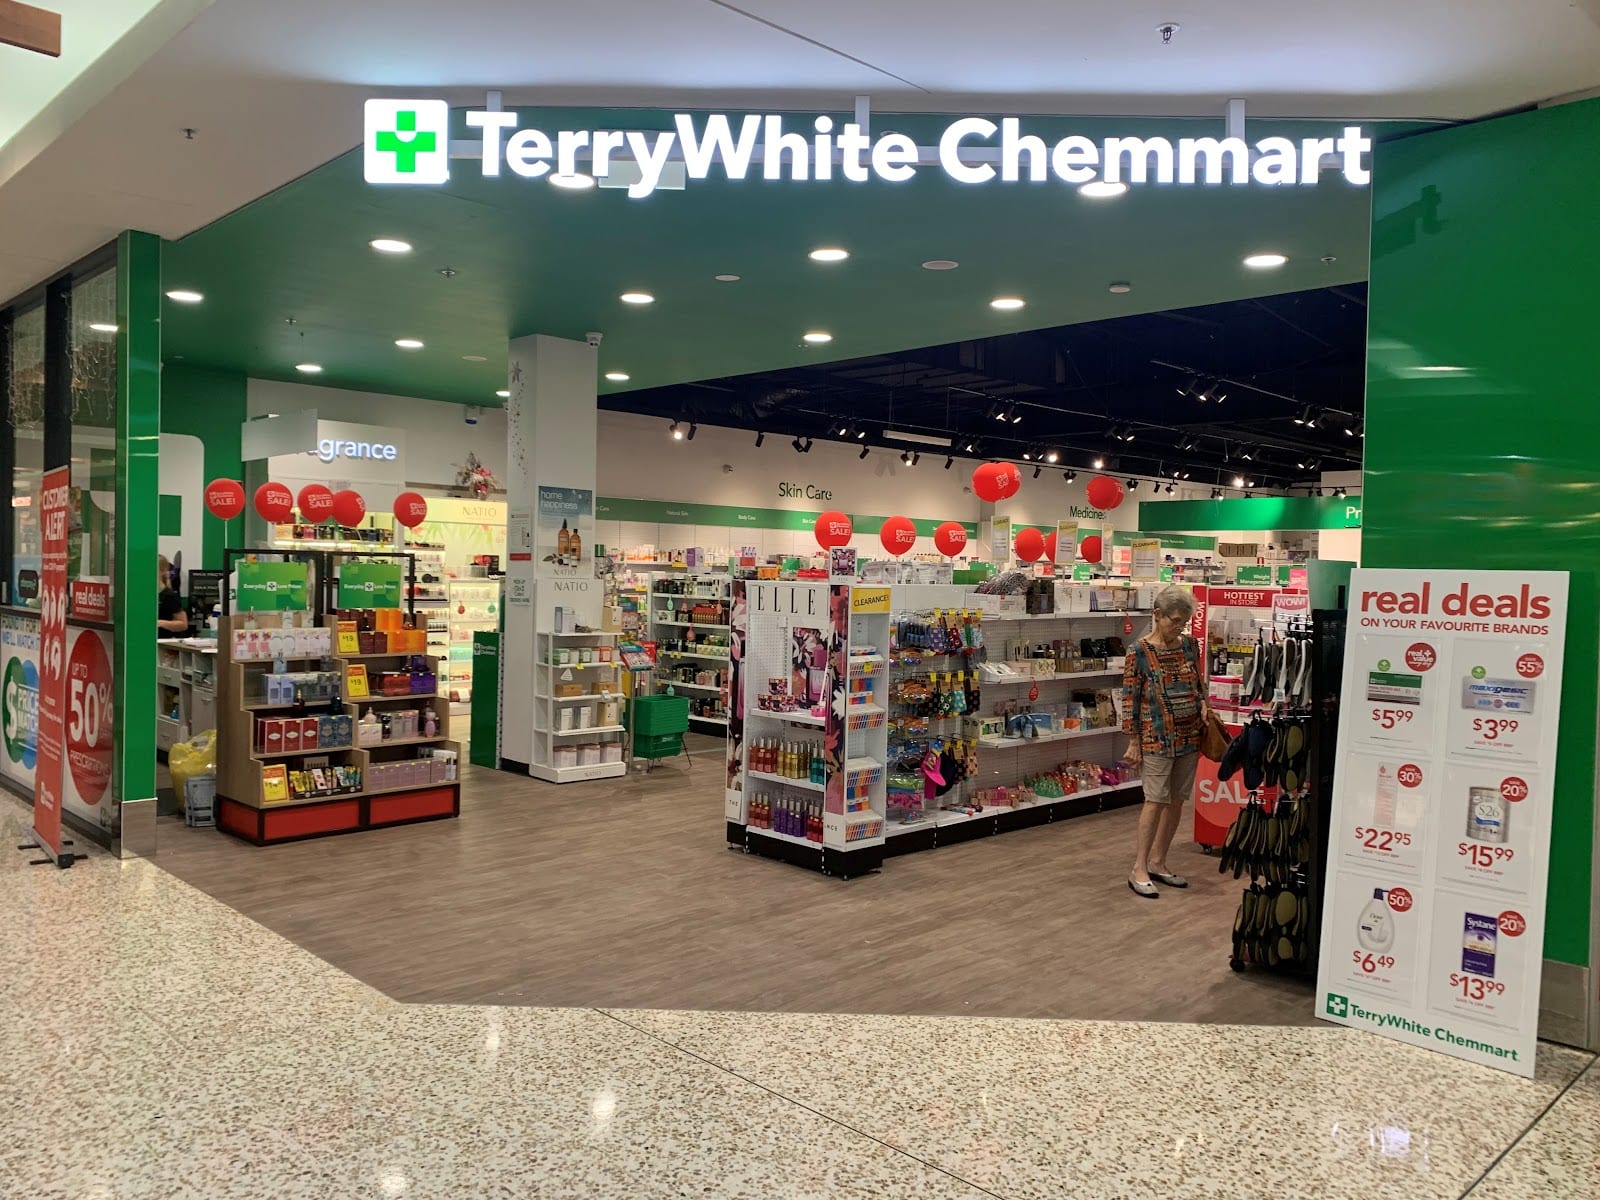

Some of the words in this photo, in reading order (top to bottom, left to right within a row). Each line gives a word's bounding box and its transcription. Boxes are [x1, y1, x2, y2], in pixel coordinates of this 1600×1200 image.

[465, 110, 918, 198] TerryWhite
[939, 116, 1372, 187] Chemmart
[42, 485, 69, 510] CUSTOMER
[540, 490, 563, 500] home
[778, 481, 803, 498] Skin
[806, 484, 833, 501] Care
[462, 506, 497, 518] NATIO
[540, 499, 578, 511] happiness
[45, 510, 66, 541] ALERT
[554, 581, 589, 592] NATIO
[75, 586, 89, 604] real
[88, 587, 105, 608] deals
[758, 585, 816, 616] ELLE
[853, 594, 890, 607] CLEARANCE!
[1223, 591, 1265, 600] HOTTEST
[1276, 597, 1307, 606] WOW!
[1361, 581, 1431, 614] real
[1441, 582, 1551, 619] deals
[1360, 617, 1380, 628] ON
[1383, 618, 1417, 630] YOUR
[1420, 620, 1490, 633] FAVOURITE
[1493, 623, 1549, 636] BRANDS
[72, 663, 79, 676] UP
[79, 664, 88, 679] TO
[1468, 684, 1529, 694] maxigesic
[70, 678, 113, 748] 50%
[1467, 917, 1497, 931] Systane
[1350, 1003, 1432, 1037] TerryWhite
[1434, 1027, 1519, 1062] Chemmart
